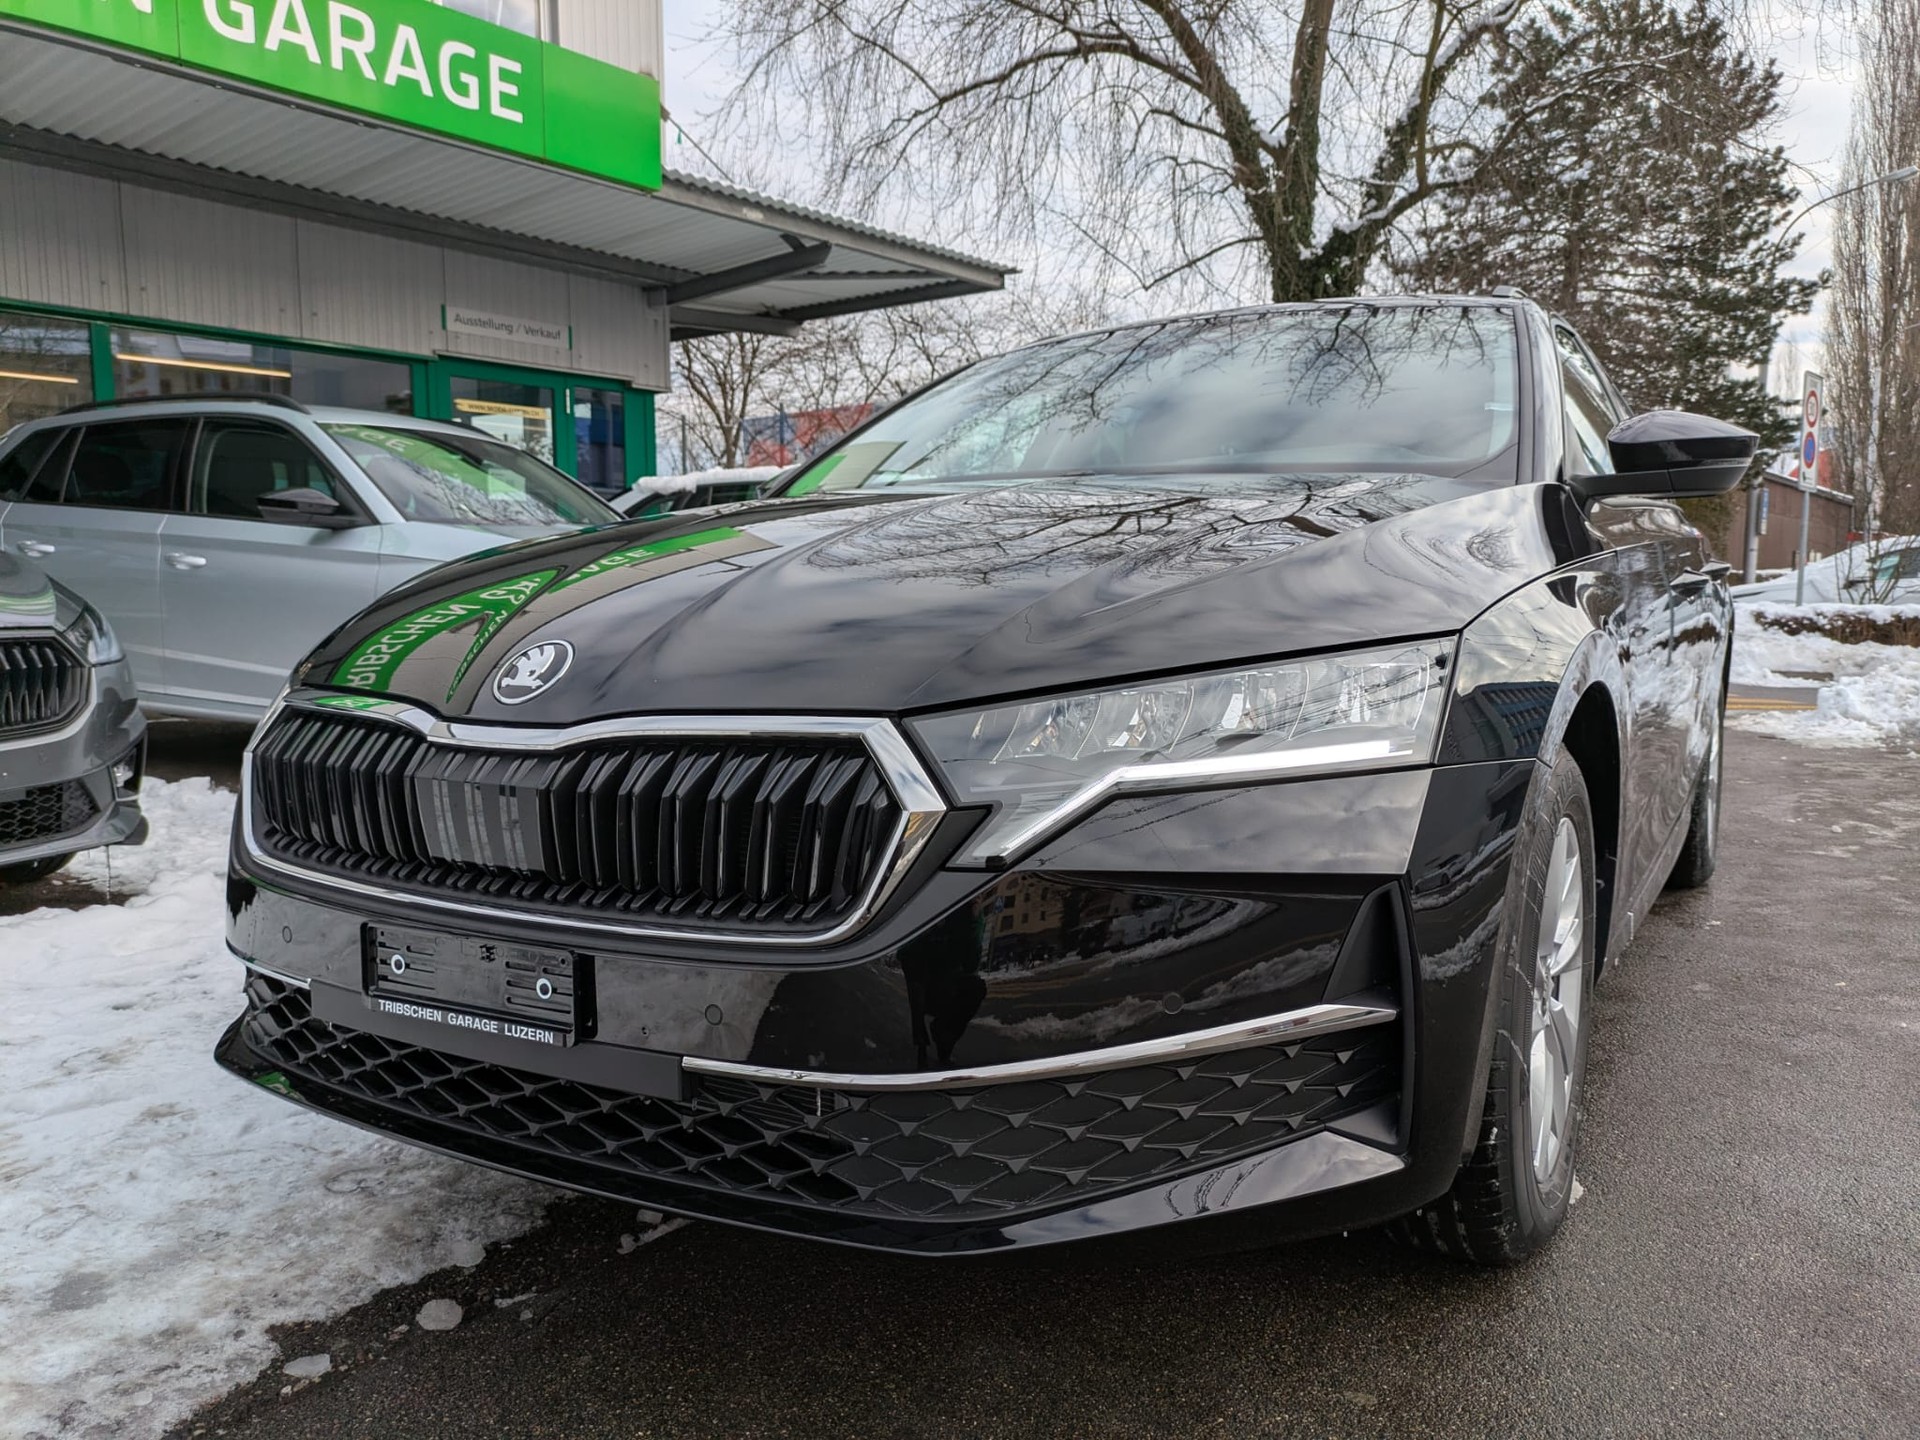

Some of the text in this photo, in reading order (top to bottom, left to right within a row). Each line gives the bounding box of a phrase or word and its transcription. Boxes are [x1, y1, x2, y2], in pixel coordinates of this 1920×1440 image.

[203, 0, 523, 123] GARAGE
[455, 314, 513, 335] Ausstellung
[524, 325, 561, 340] Verkauf
[378, 999, 554, 1044] TRIBSCHEN GARAGE LUZERN
